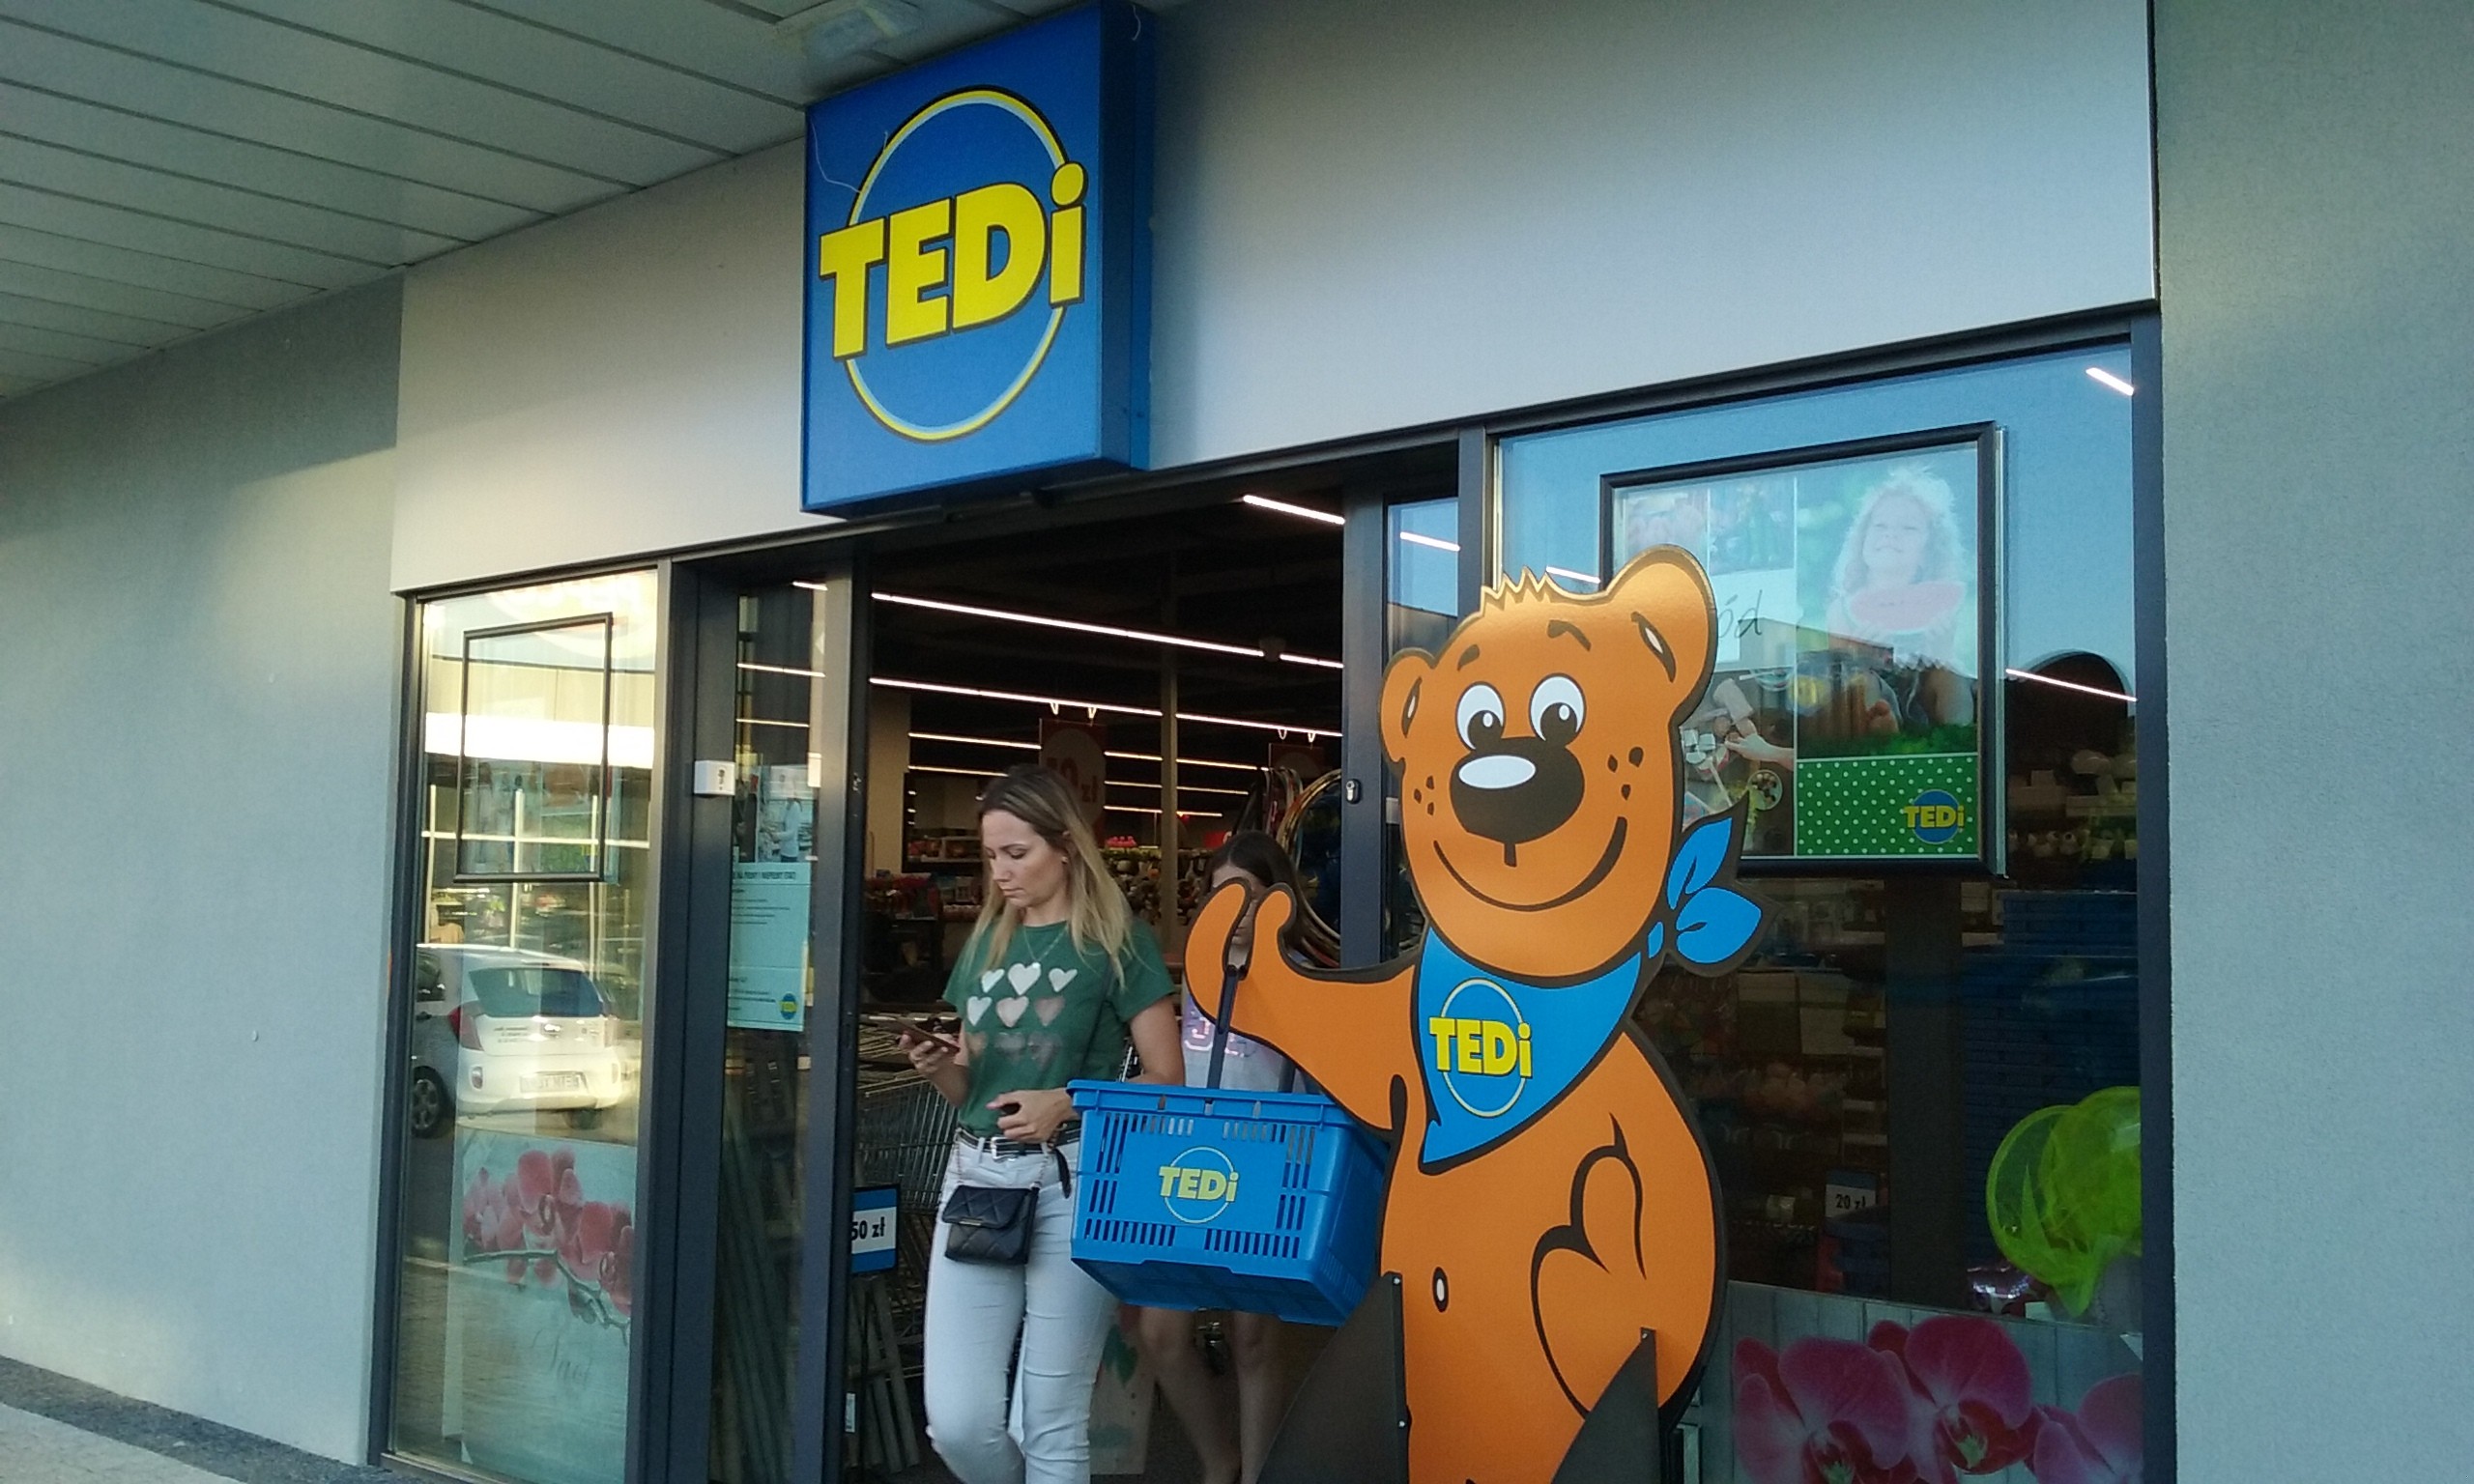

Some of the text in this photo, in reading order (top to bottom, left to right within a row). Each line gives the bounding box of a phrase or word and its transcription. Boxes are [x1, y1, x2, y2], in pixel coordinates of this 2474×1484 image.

[820, 160, 1087, 361] TEDi
[1903, 805, 1965, 829] TEDi
[1428, 1016, 1533, 1079] TEDi
[1159, 1165, 1240, 1203] TEDi
[1835, 1193, 1851, 1210] 20
[850, 1216, 885, 1241] 50 zł
